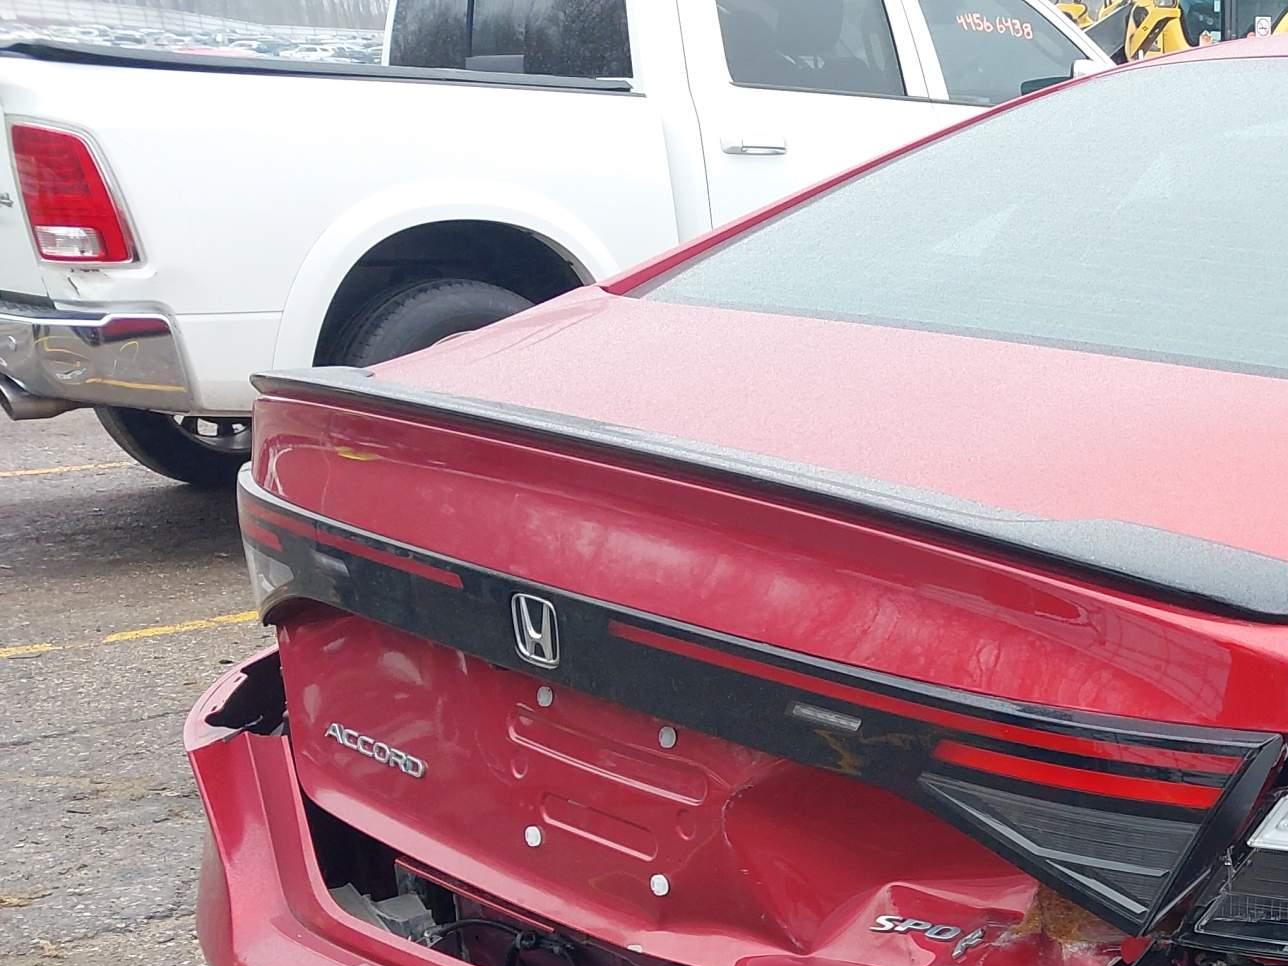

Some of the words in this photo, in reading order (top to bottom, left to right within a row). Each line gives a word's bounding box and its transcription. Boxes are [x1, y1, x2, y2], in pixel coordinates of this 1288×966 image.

[956, 12, 993, 32] 4456
[995, 16, 1033, 40] 6438
[324, 722, 427, 778] ACCORD
